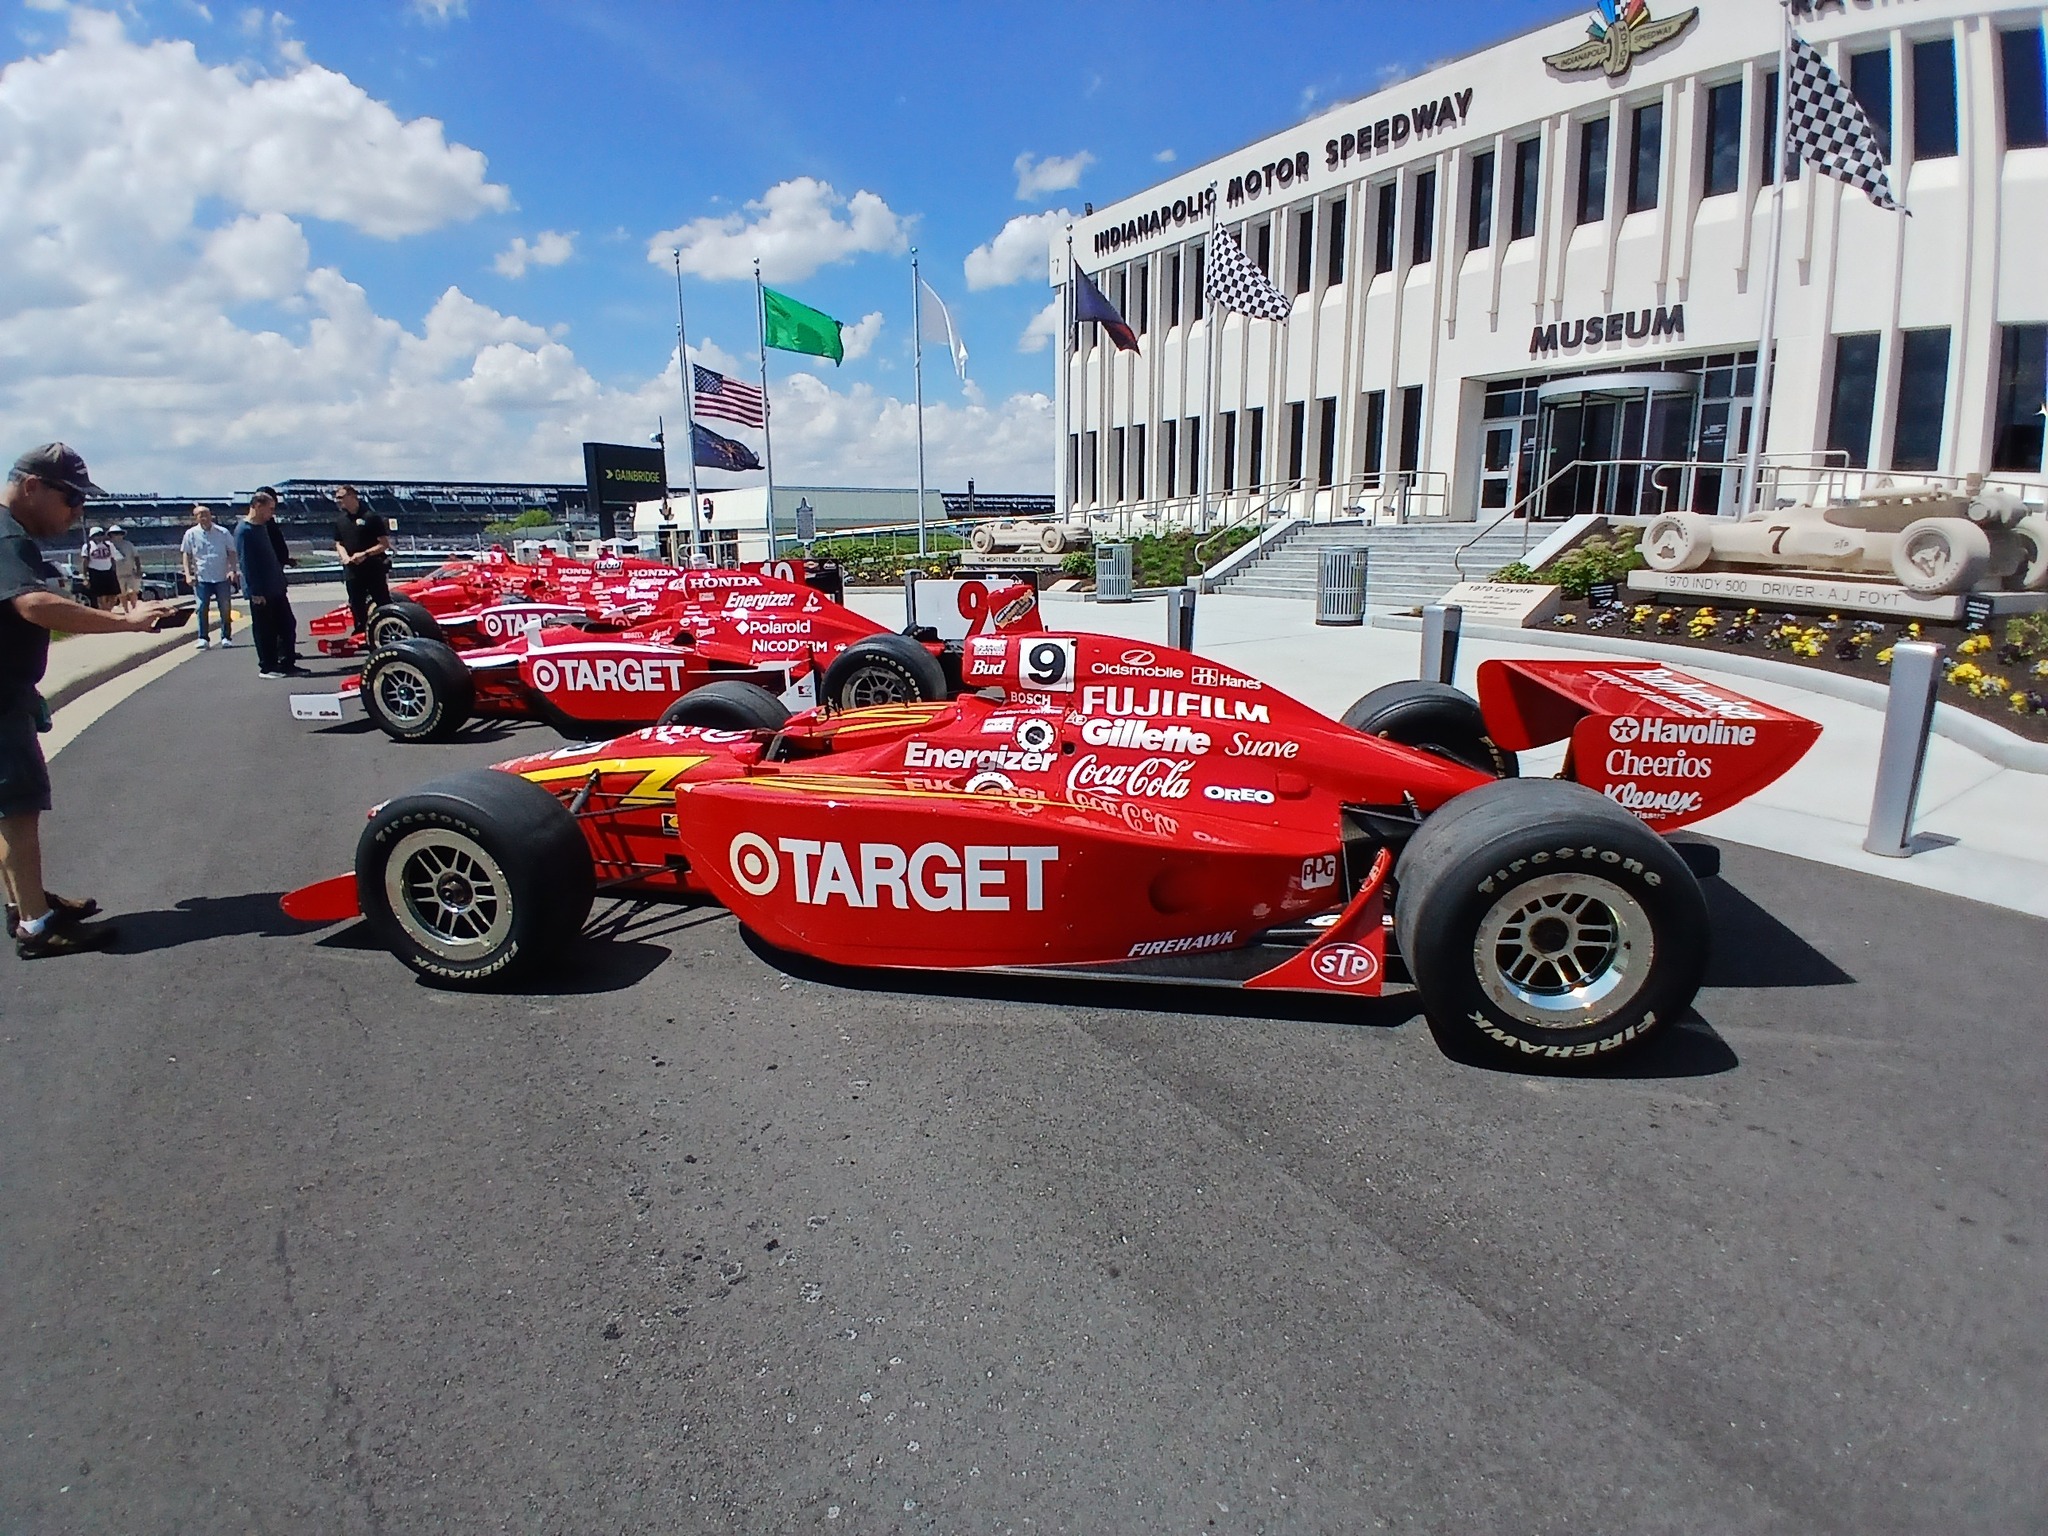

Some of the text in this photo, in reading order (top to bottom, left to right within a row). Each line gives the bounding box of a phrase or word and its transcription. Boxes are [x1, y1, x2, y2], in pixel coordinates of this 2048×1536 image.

[1617, 25, 1629, 66] MOTOR
[1633, 25, 1674, 44] SPEEDWAY
[1560, 45, 1607, 67] INDIANAPOLIS
[1094, 88, 1473, 255] INDIANAPOLIS MOTOR SPEEDWAY
[1529, 304, 1684, 354] MUSEUM
[615, 468, 660, 483] GAINBRIDGE
[1768, 526, 1791, 554] 7
[627, 569, 679, 577] HONDA
[689, 576, 763, 588] HONDA
[725, 591, 796, 610] Energizer
[1664, 574, 1688, 588] 1970
[1692, 577, 1722, 592] INDY
[1725, 580, 1747, 593] 500
[1761, 584, 1815, 599] DRIVER
[1827, 588, 1840, 601] A
[1842, 590, 1850, 602] J
[1858, 592, 1901, 606] FOYT
[957, 580, 989, 640] 9
[750, 620, 811, 634] Polaroid
[557, 658, 685, 692] TARGET
[970, 660, 1007, 675] Bud
[1028, 643, 1066, 685] 9
[1091, 663, 1184, 679] Oldsmobile
[1219, 674, 1262, 690] Hanes
[1010, 691, 1052, 708] BOSCH
[1082, 685, 1271, 724] FUJIFILM
[1081, 718, 1212, 755] Gillette
[1225, 732, 1300, 759] Suave
[1641, 717, 1757, 746] Havoline
[904, 741, 1059, 774] Energizer
[1606, 749, 1712, 778] Cheerios
[1066, 754, 1197, 799] Coca-Cola
[1204, 785, 1275, 804] OREO
[1604, 782, 1702, 815] Kleenex
[778, 837, 1059, 912] TARGET
[1303, 856, 1335, 882] PPG
[1477, 845, 1662, 894] Firestone
[1127, 930, 1238, 957] FIREHAWK
[412, 940, 519, 979] FIREHAWK
[1319, 949, 1369, 977] STP
[1467, 1009, 1658, 1059] FIREHAWK
